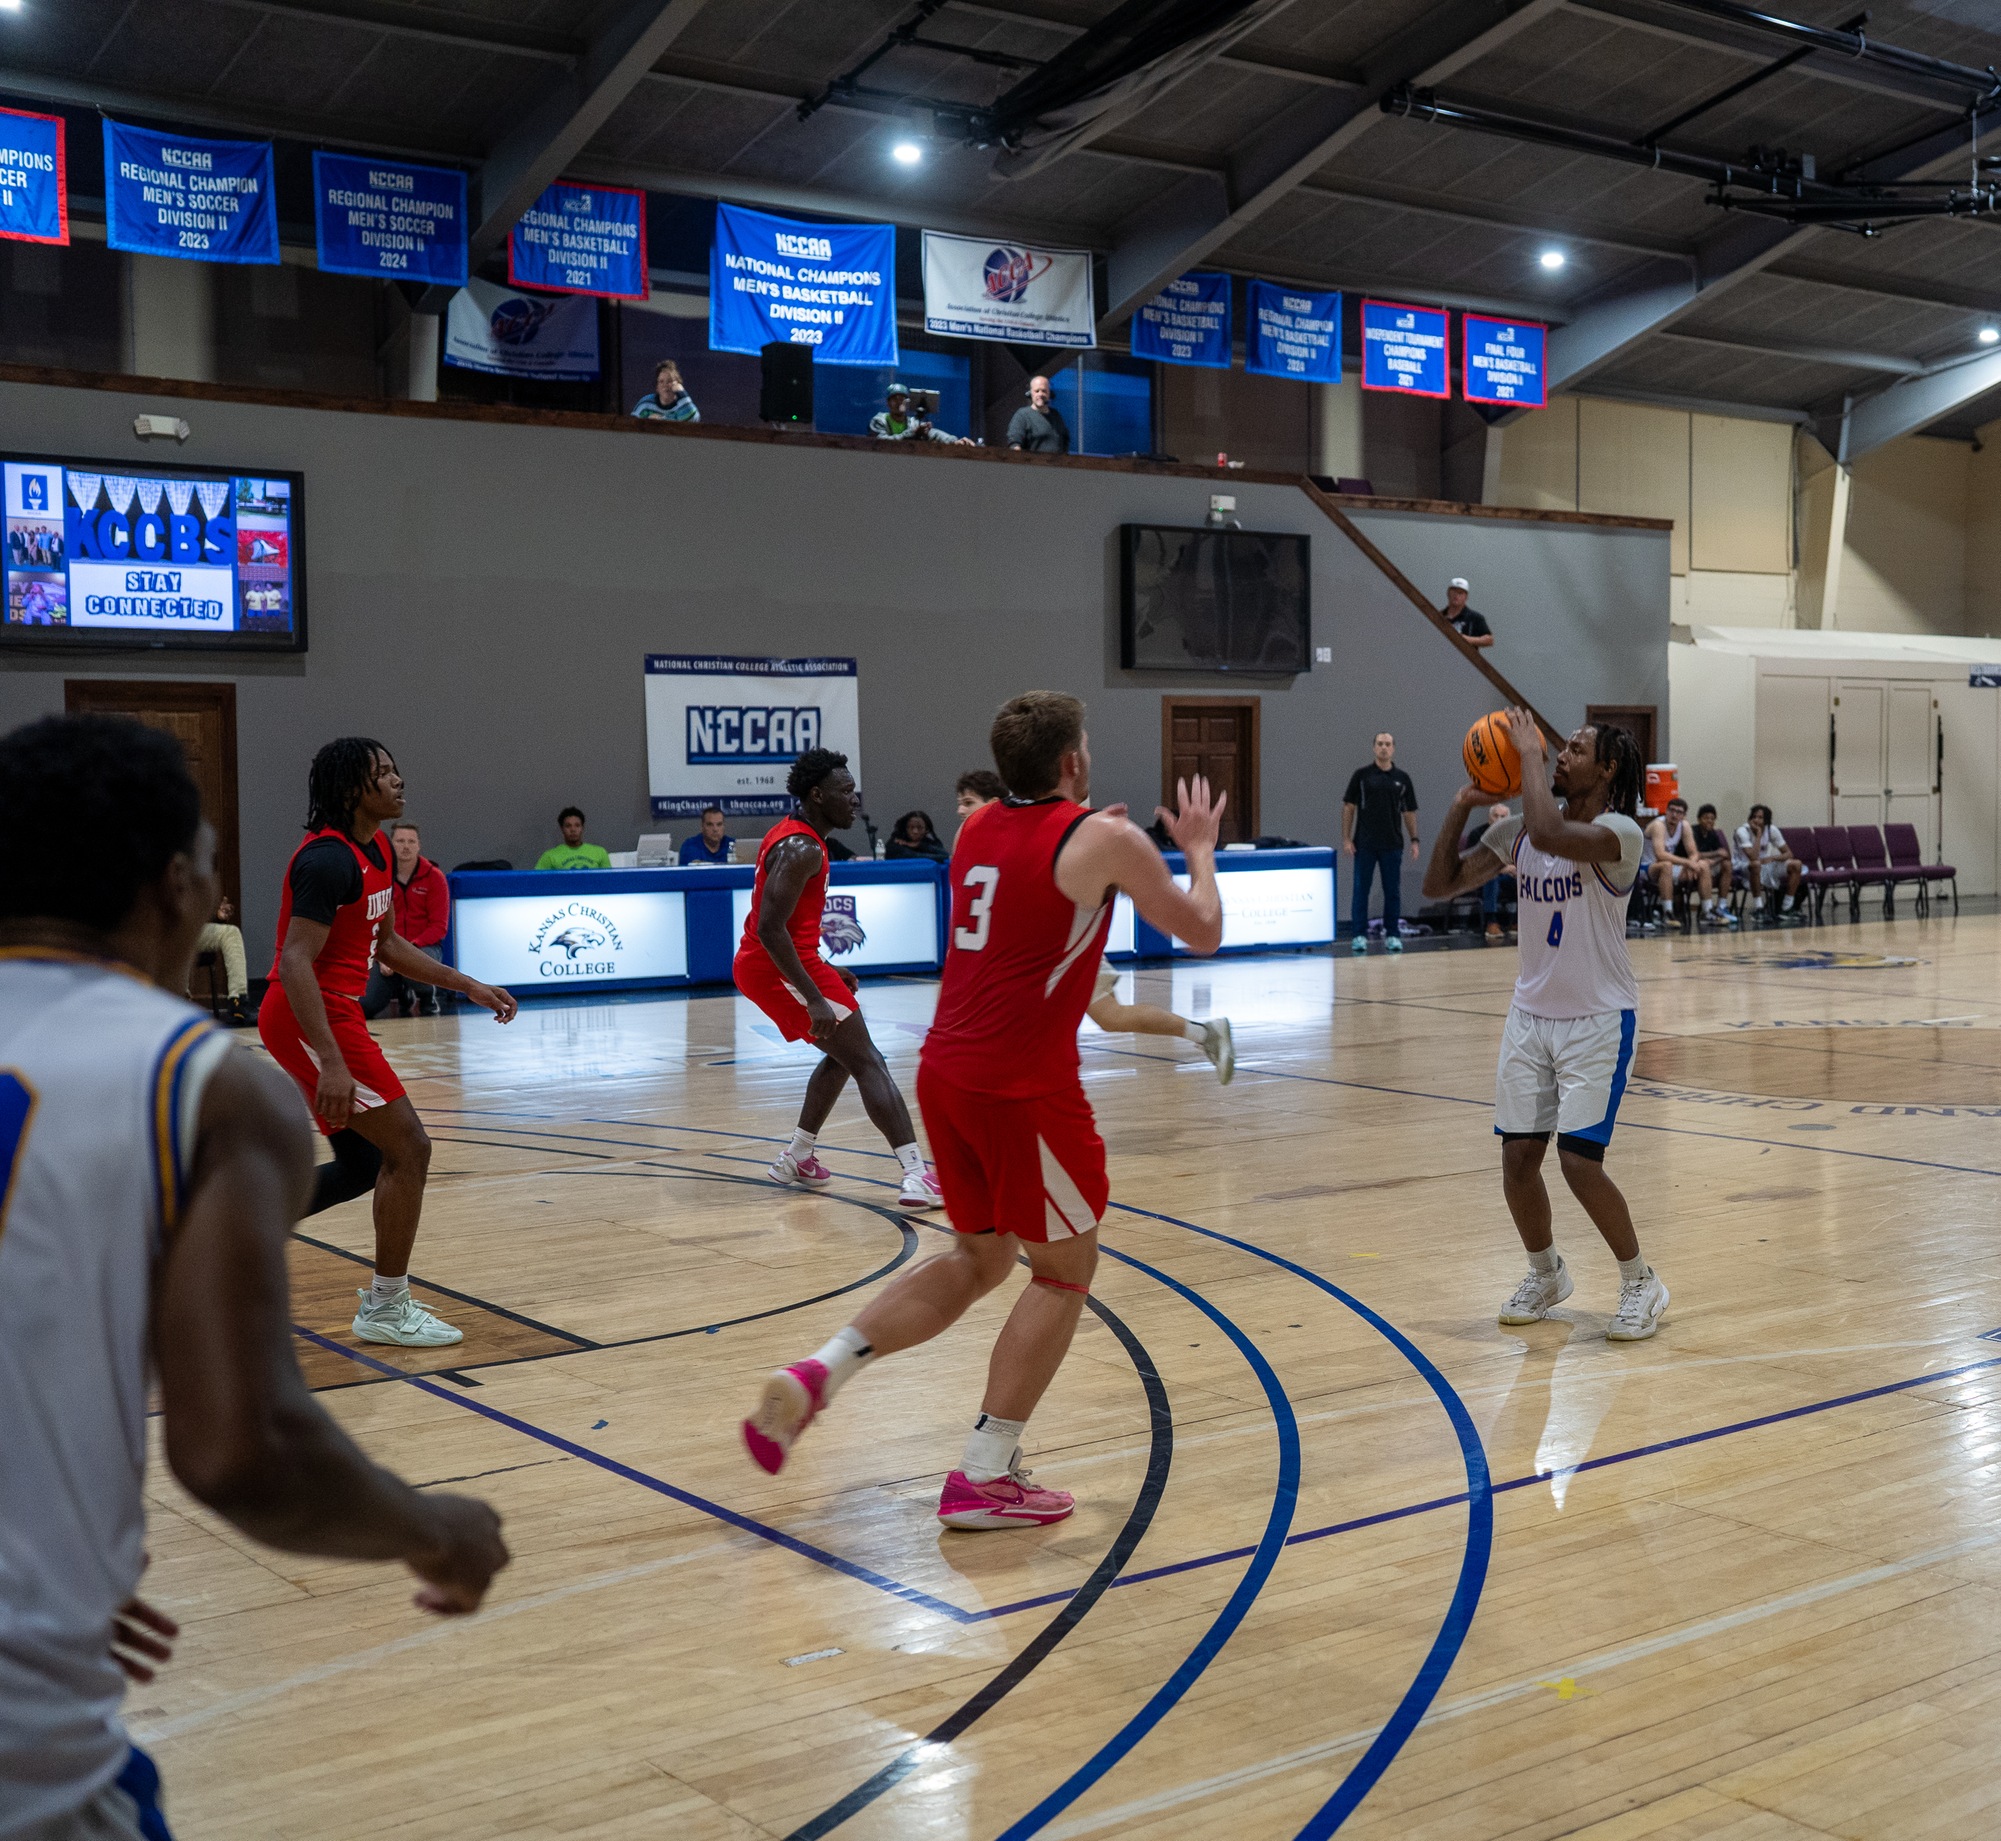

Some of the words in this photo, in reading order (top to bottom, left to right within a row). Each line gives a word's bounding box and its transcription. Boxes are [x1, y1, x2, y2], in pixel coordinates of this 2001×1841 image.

[161, 148, 212, 168] NCCAA
[120, 162, 185, 190] REGIONAL
[189, 175, 258, 193] CHAMPION
[369, 171, 414, 189] NCCAA
[3, 189, 13, 206] II
[143, 186, 185, 208] MEN'S
[188, 194, 239, 213] SOCCER
[328, 189, 389, 211] REGIONAL
[391, 197, 454, 219] CHAMPION
[158, 208, 215, 230] DIVISION
[218, 215, 228, 231] II
[348, 211, 386, 229] MEN'S
[389, 215, 435, 235] SOCCER
[573, 217, 638, 239] CHAMPIONS
[179, 231, 209, 249] 2023
[362, 231, 414, 250] DIVISION
[417, 238, 425, 251] II
[524, 227, 560, 247] MEN'S
[562, 233, 629, 255] BASKETBALL
[775, 232, 832, 259] NCCAA
[380, 252, 407, 269] 2024
[548, 248, 597, 268] DIVISION
[600, 256, 608, 269] II
[566, 269, 591, 285] 2021
[725, 253, 795, 281] NATIONAL
[797, 268, 881, 286] CHAMPIONS
[733, 277, 780, 297] MEN'S
[782, 285, 874, 306] BASKETBALL
[770, 304, 832, 324] DIVISION
[834, 311, 844, 325] II
[1171, 313, 1219, 329] BASKETBALL
[790, 328, 823, 345] 2023
[973, 325, 1005, 337] National
[1006, 328, 1044, 341] Basketball
[1045, 332, 1088, 345] Champions
[1160, 326, 1196, 342] DIVISION
[1285, 329, 1329, 347] BASKETBALL
[1495, 358, 1537, 375] BASKETBALL
[126, 572, 181, 592] STAY
[86, 595, 223, 620] CONNECTED
[654, 659, 692, 670] NATIONAL
[694, 660, 733, 670] CHRISTIAN
[735, 661, 769, 672] COLLEGE
[804, 663, 849, 673] ASSOCIATION
[688, 708, 820, 754] NCCAA
[737, 777, 752, 785] est.
[755, 776, 774, 785] 1968
[730, 800, 784, 810] thenccaa.org
[1520, 871, 1583, 903] FALCONS
[954, 864, 1000, 952] 3
[1242, 908, 1288, 918] COLLEGE
[528, 908, 565, 954] KANSAS
[568, 902, 624, 951] CHRISTIAN
[540, 961, 615, 977] COLLEGE
